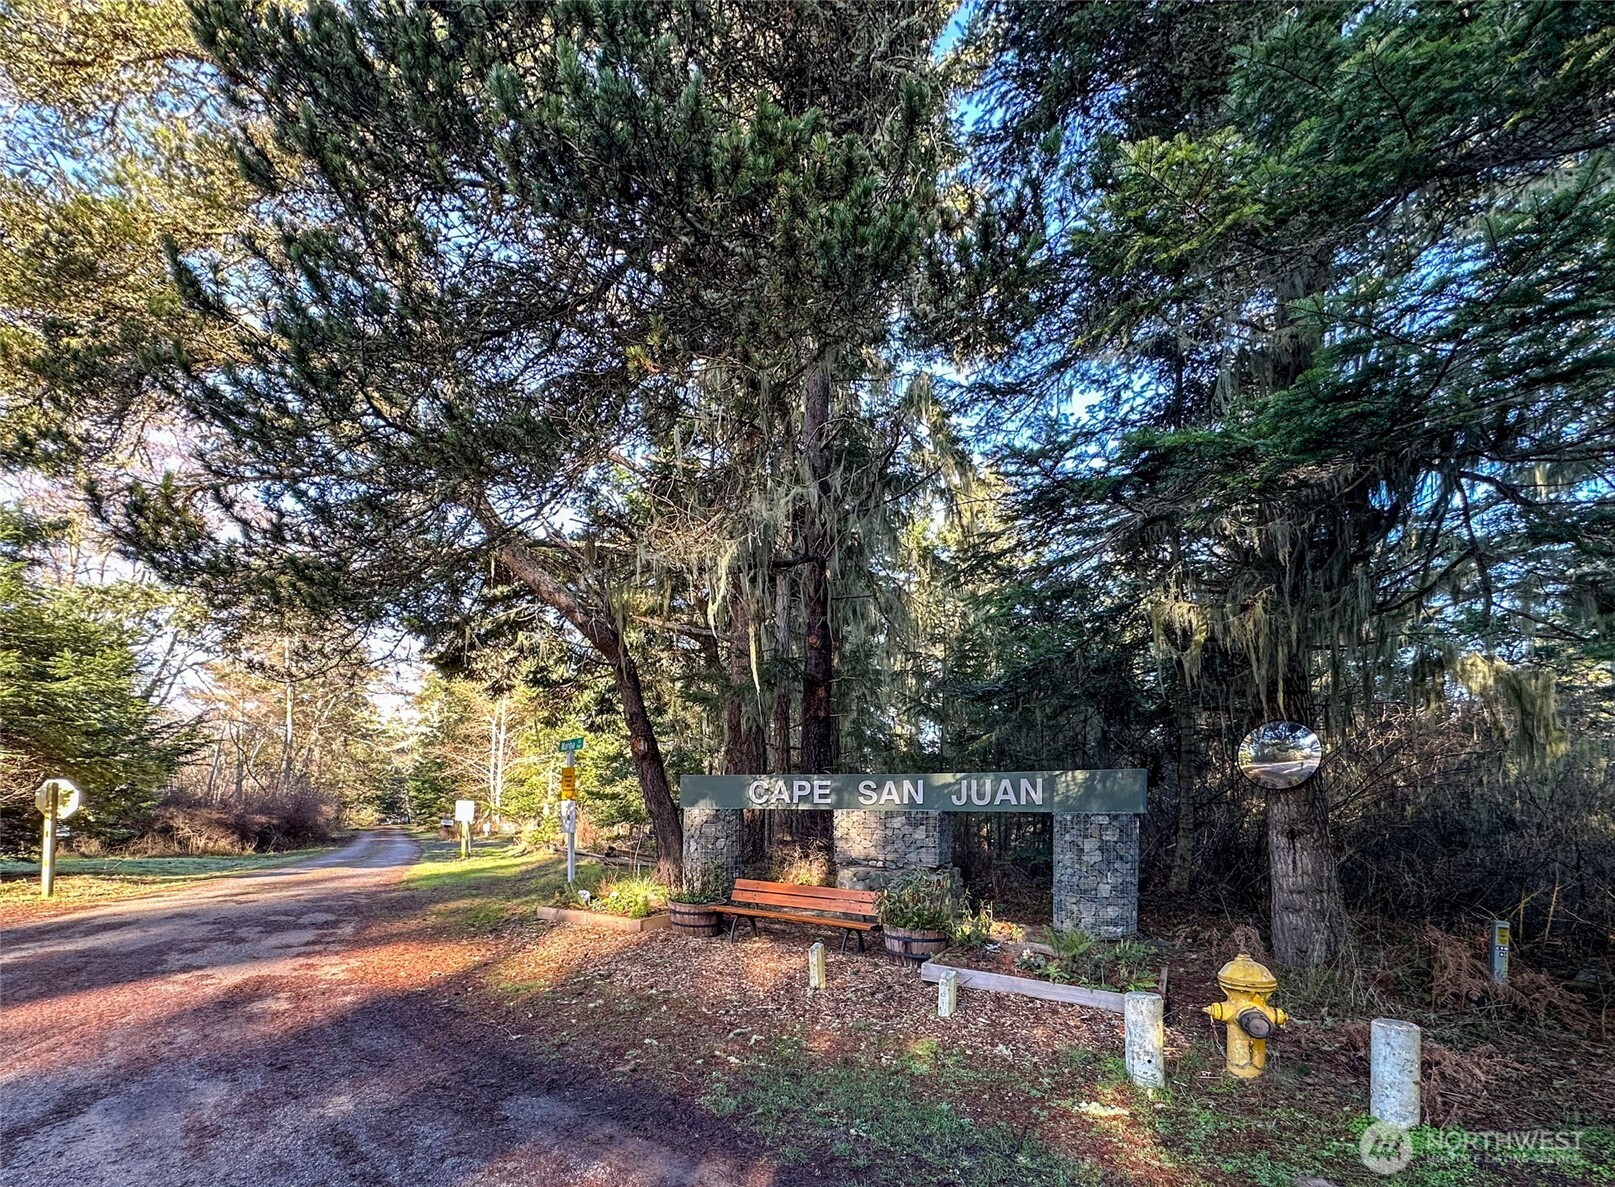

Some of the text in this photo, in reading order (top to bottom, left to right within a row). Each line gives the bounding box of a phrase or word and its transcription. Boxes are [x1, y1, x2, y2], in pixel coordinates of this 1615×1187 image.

[749, 778, 1043, 806] CAPE SAN JUAN
